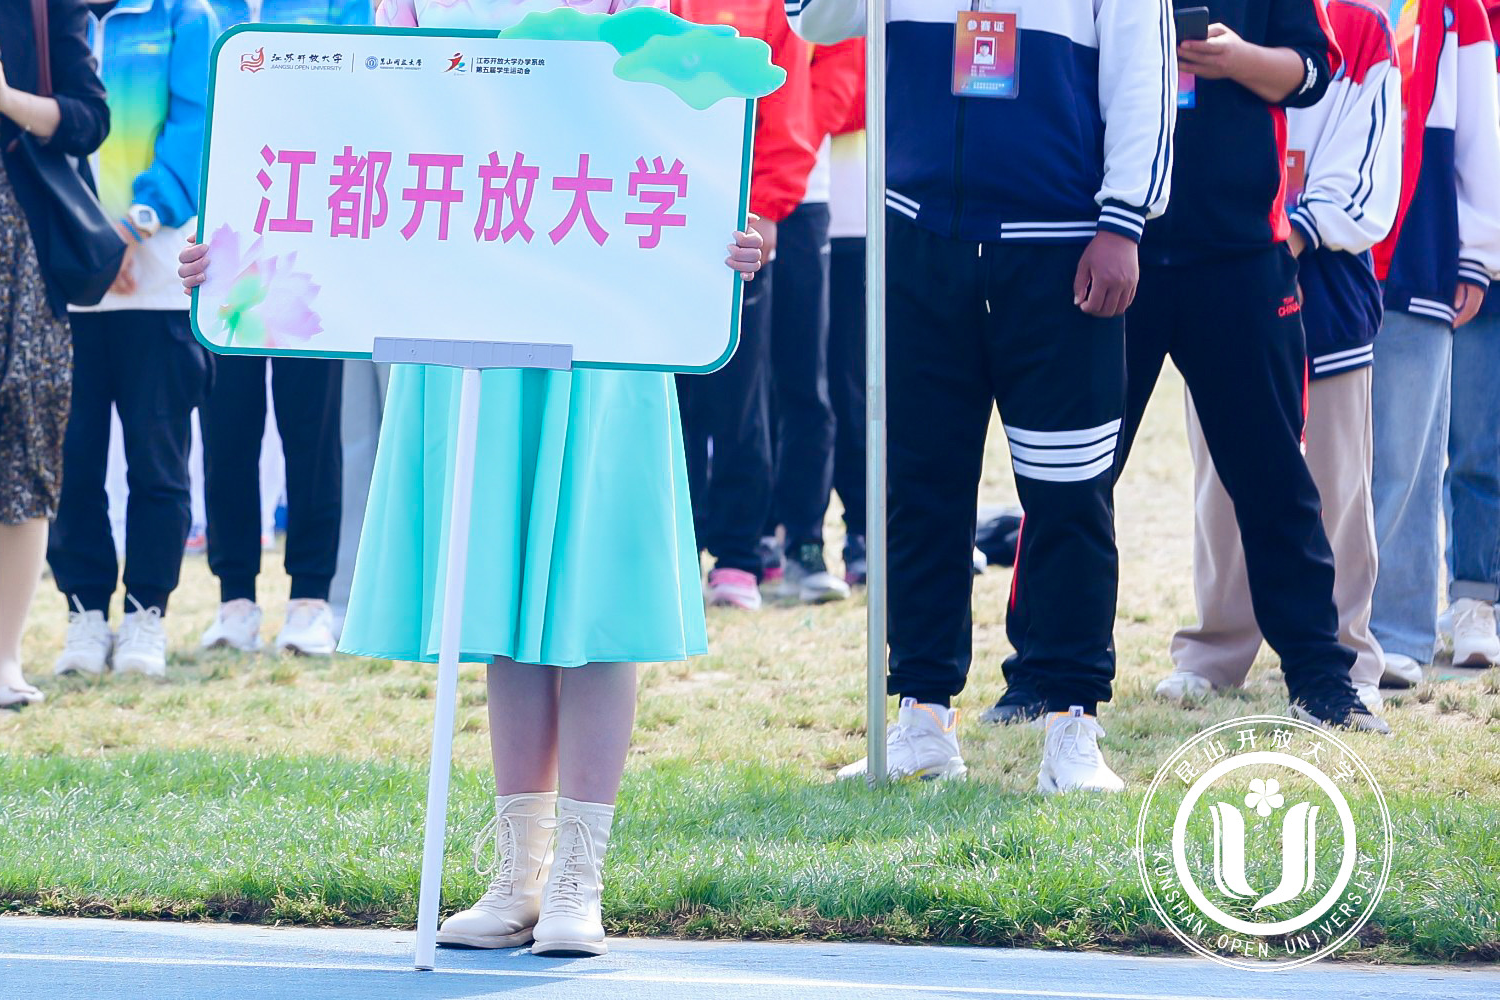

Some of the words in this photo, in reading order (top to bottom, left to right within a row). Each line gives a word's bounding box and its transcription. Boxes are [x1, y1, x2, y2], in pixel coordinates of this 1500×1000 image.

[476, 56, 546, 67] 江苏开放大学办学系统
[476, 65, 532, 75] 第五届学生运动会
[252, 143, 690, 250] 江都开放大学
